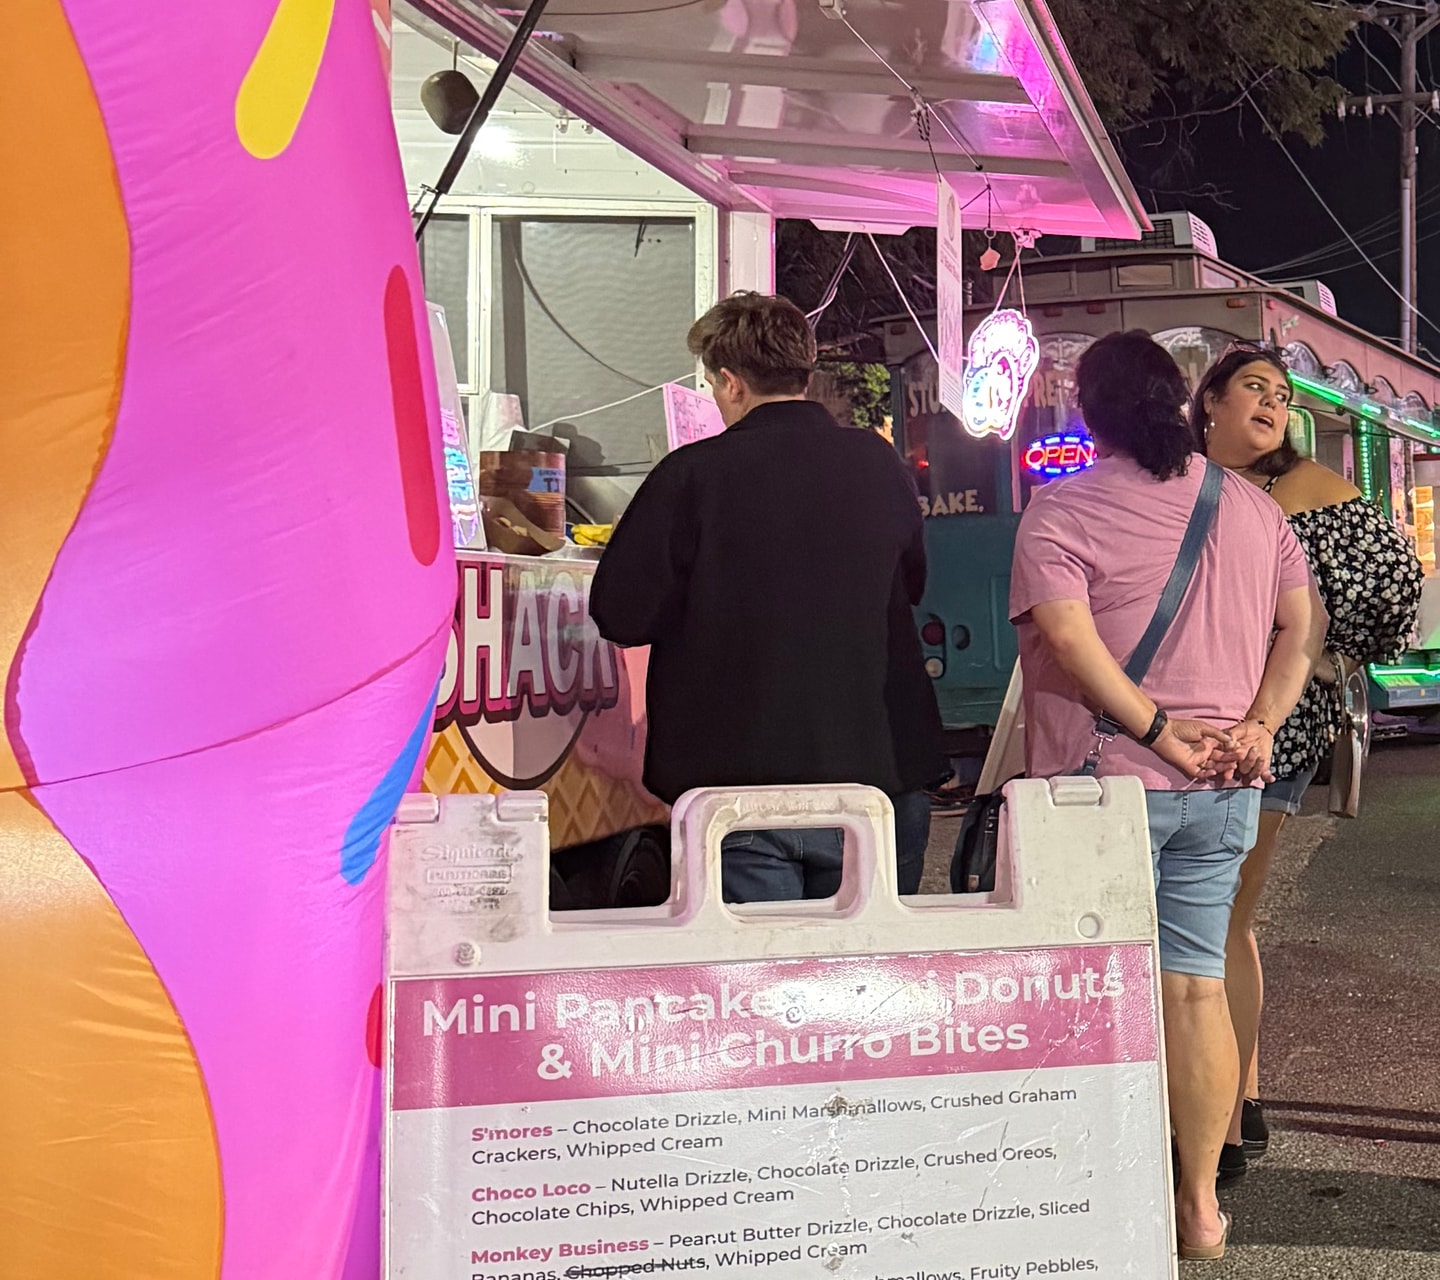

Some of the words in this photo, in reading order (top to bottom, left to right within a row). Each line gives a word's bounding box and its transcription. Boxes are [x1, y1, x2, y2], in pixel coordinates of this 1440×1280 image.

[1025, 445, 1094, 466] OPEN
[423, 991, 535, 1036] Mini
[954, 967, 1125, 1005] Donuts
[537, 1044, 573, 1080] &
[592, 1031, 699, 1077] Mini
[719, 1028, 892, 1068] Churro
[910, 1018, 1029, 1056] Bites
[472, 1125, 553, 1142] S'mores
[573, 1116, 669, 1135] Chocolate
[676, 1111, 742, 1128] Drizzle,
[748, 1106, 786, 1122] Mini
[793, 1097, 926, 1120] Marshmallows,
[931, 1092, 1003, 1110] Crushed
[1009, 1088, 1077, 1103] Graham
[472, 1145, 561, 1165] Crackers,
[567, 1138, 655, 1159] Whipped
[661, 1134, 723, 1151] Cream
[472, 1187, 536, 1202] Choco
[543, 1182, 591, 1197] Loco
[612, 1175, 678, 1192] Nutella
[686, 1169, 751, 1187] Drizzle,
[757, 1161, 850, 1181] Chocolate
[855, 1157, 919, 1173] Drizzle,
[924, 1149, 997, 1168] Crushed
[1003, 1146, 1057, 1162] Oreos,
[472, 1206, 570, 1225] Chocolate
[576, 1200, 635, 1219] Chips,
[640, 1192, 727, 1213] Whipped
[733, 1189, 793, 1205] Cream
[472, 1245, 553, 1264] Monkey
[559, 1237, 649, 1258] Business
[670, 1230, 736, 1248] Peanut
[743, 1225, 801, 1242] Butter
[808, 1218, 872, 1237] Drizzle,
[878, 1211, 967, 1230] Chocolate
[973, 1204, 1035, 1222] Drizzle,
[1040, 1199, 1090, 1216] Sliced
[565, 1258, 655, 1280] Chopped
[662, 1256, 709, 1271] Nuts,
[715, 1247, 801, 1266] Whipped
[808, 1241, 867, 1259] Cream
[971, 1264, 1020, 1280] Fruity
[1026, 1257, 1098, 1276] Pebbles,
